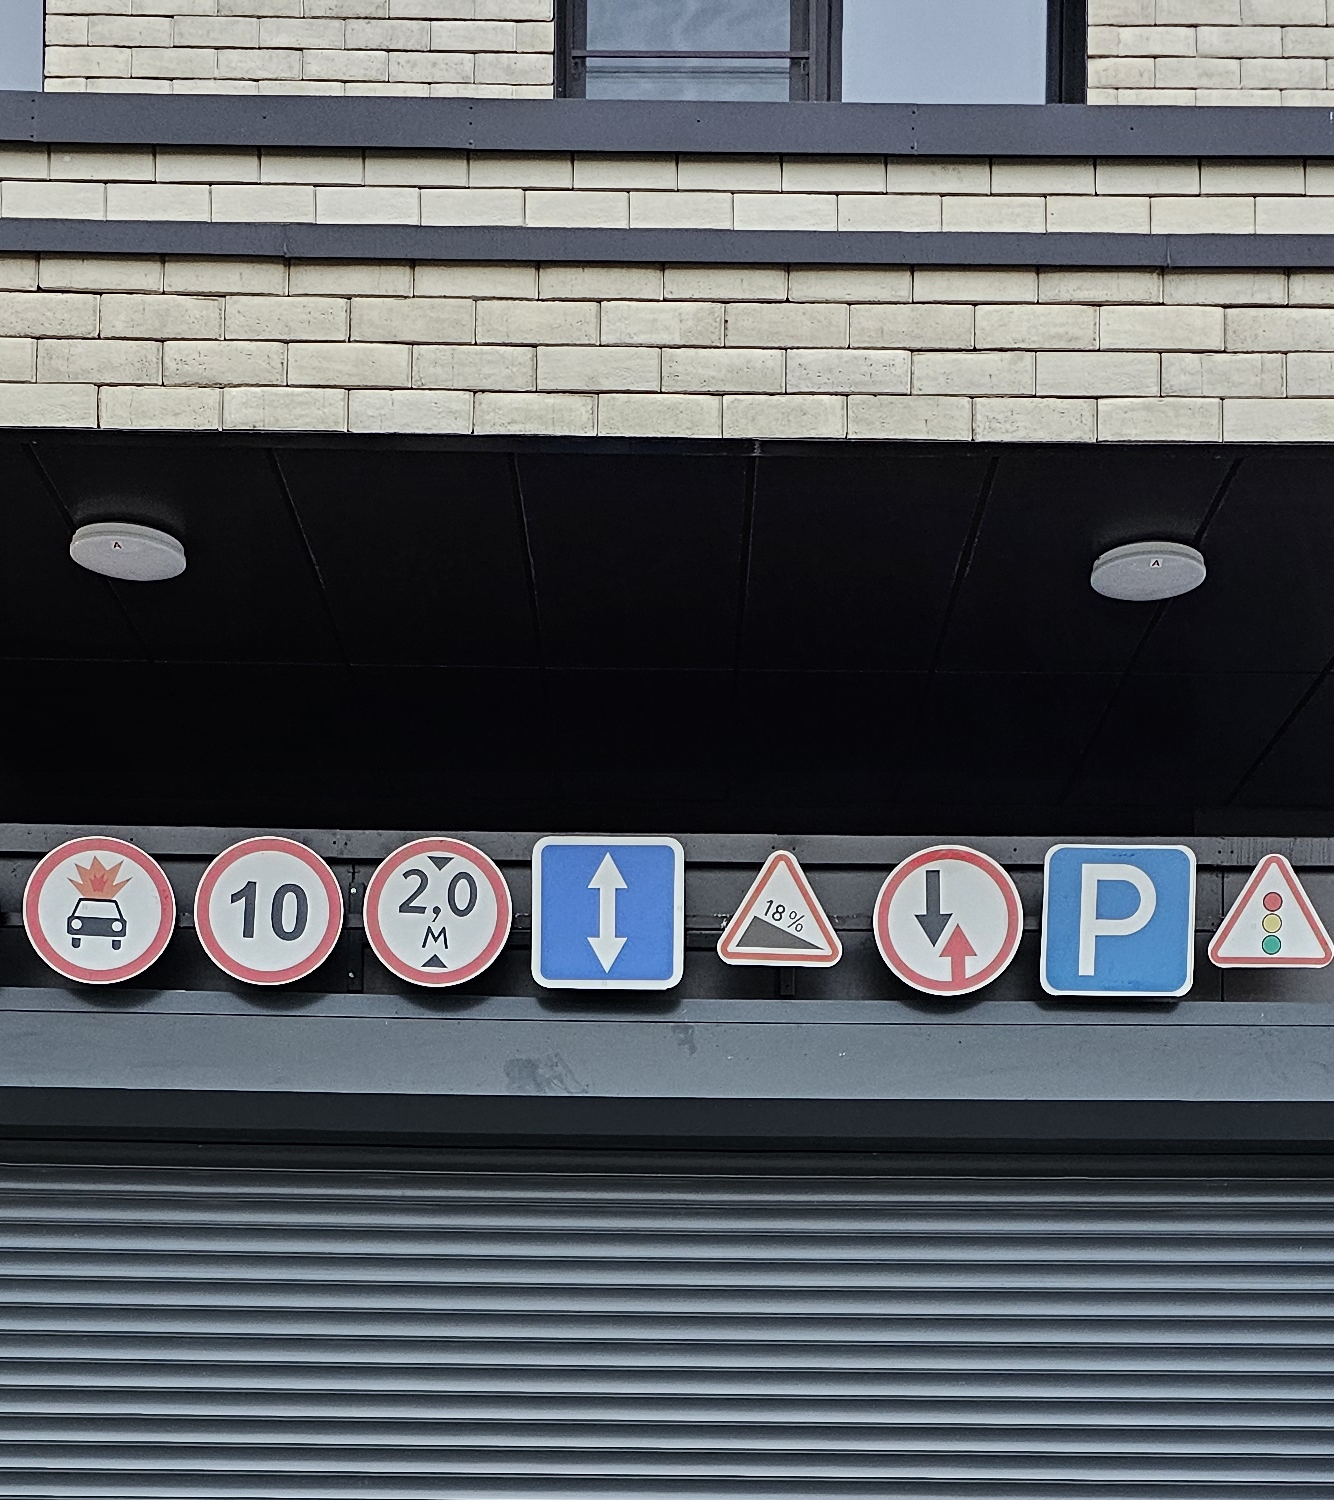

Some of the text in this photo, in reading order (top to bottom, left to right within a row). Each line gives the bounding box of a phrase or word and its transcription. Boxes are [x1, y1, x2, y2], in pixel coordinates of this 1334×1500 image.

[230, 880, 309, 942] 10
[398, 868, 479, 923] 2,0
[763, 899, 806, 933] 18%
[1078, 862, 1157, 976] P
